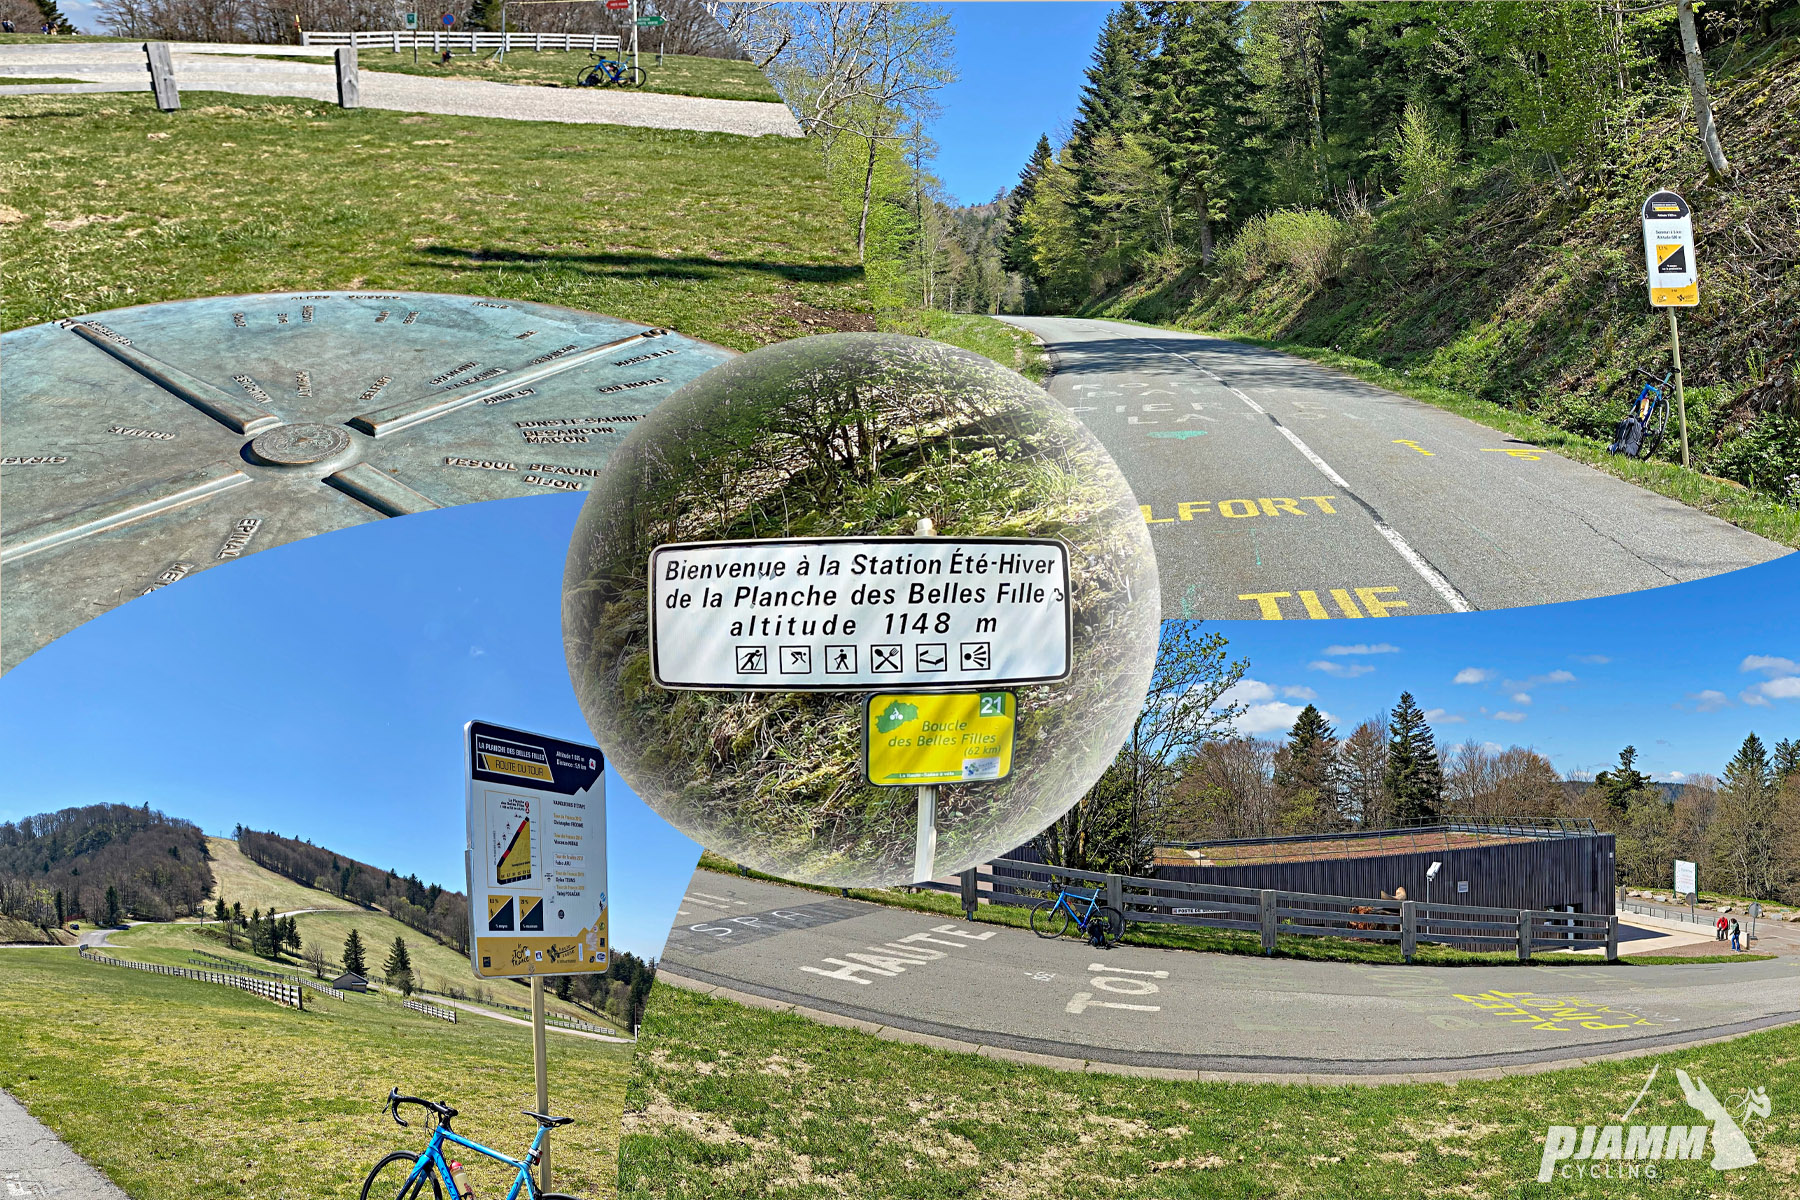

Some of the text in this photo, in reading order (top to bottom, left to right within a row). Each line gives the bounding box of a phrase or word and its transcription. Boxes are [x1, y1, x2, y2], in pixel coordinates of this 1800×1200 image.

[516, 420, 559, 428] LONS
[444, 456, 518, 472] VESOUL
[524, 475, 582, 490] DIJON
[665, 548, 1056, 582] Bienvenue à la Station Été-Hiver
[665, 588, 692, 609] de
[702, 588, 724, 608] la
[734, 586, 838, 608] Planche
[850, 584, 896, 606] des
[908, 582, 987, 604] Belles
[730, 612, 998, 638] altitude 1148 m
[980, 696, 1004, 714] 21
[922, 720, 968, 732] Boucle
[478, 742, 484, 750] LA
[888, 732, 997, 747] des Belles Filles
[964, 745, 1002, 757] (62 km)
[495, 759, 544, 776] ROUTE DU TOUR
